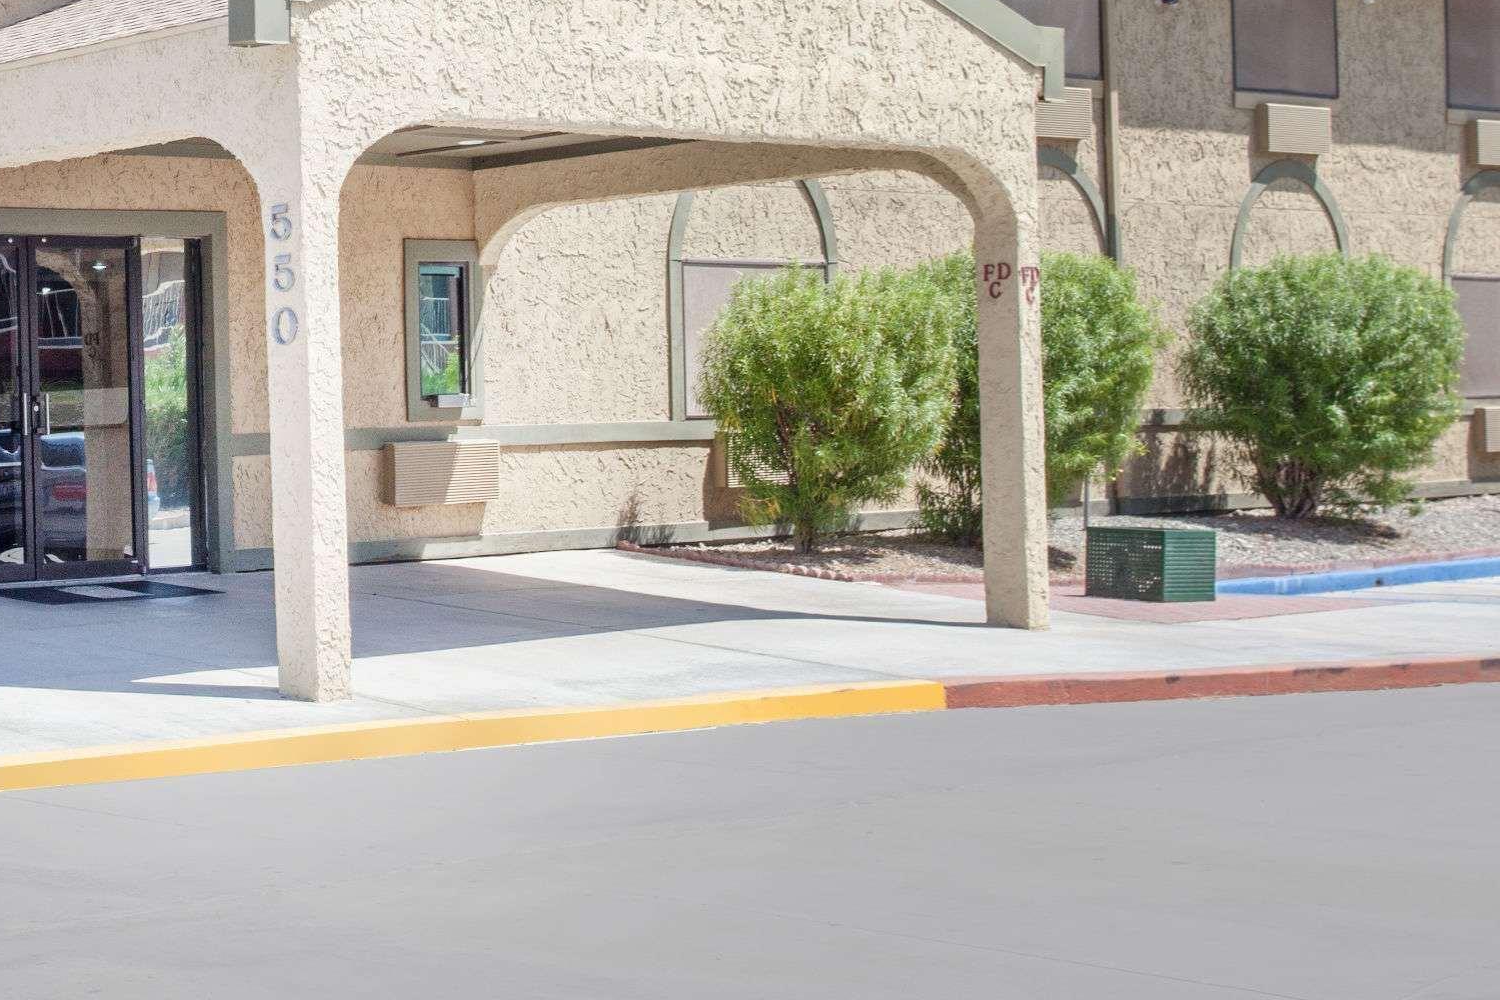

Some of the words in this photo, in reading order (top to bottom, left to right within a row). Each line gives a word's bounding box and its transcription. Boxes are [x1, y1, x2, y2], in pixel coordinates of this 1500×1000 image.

[270, 203, 299, 345] 550
[983, 262, 1011, 281] FD
[1020, 266, 1040, 286] FD
[989, 281, 1003, 299] C
